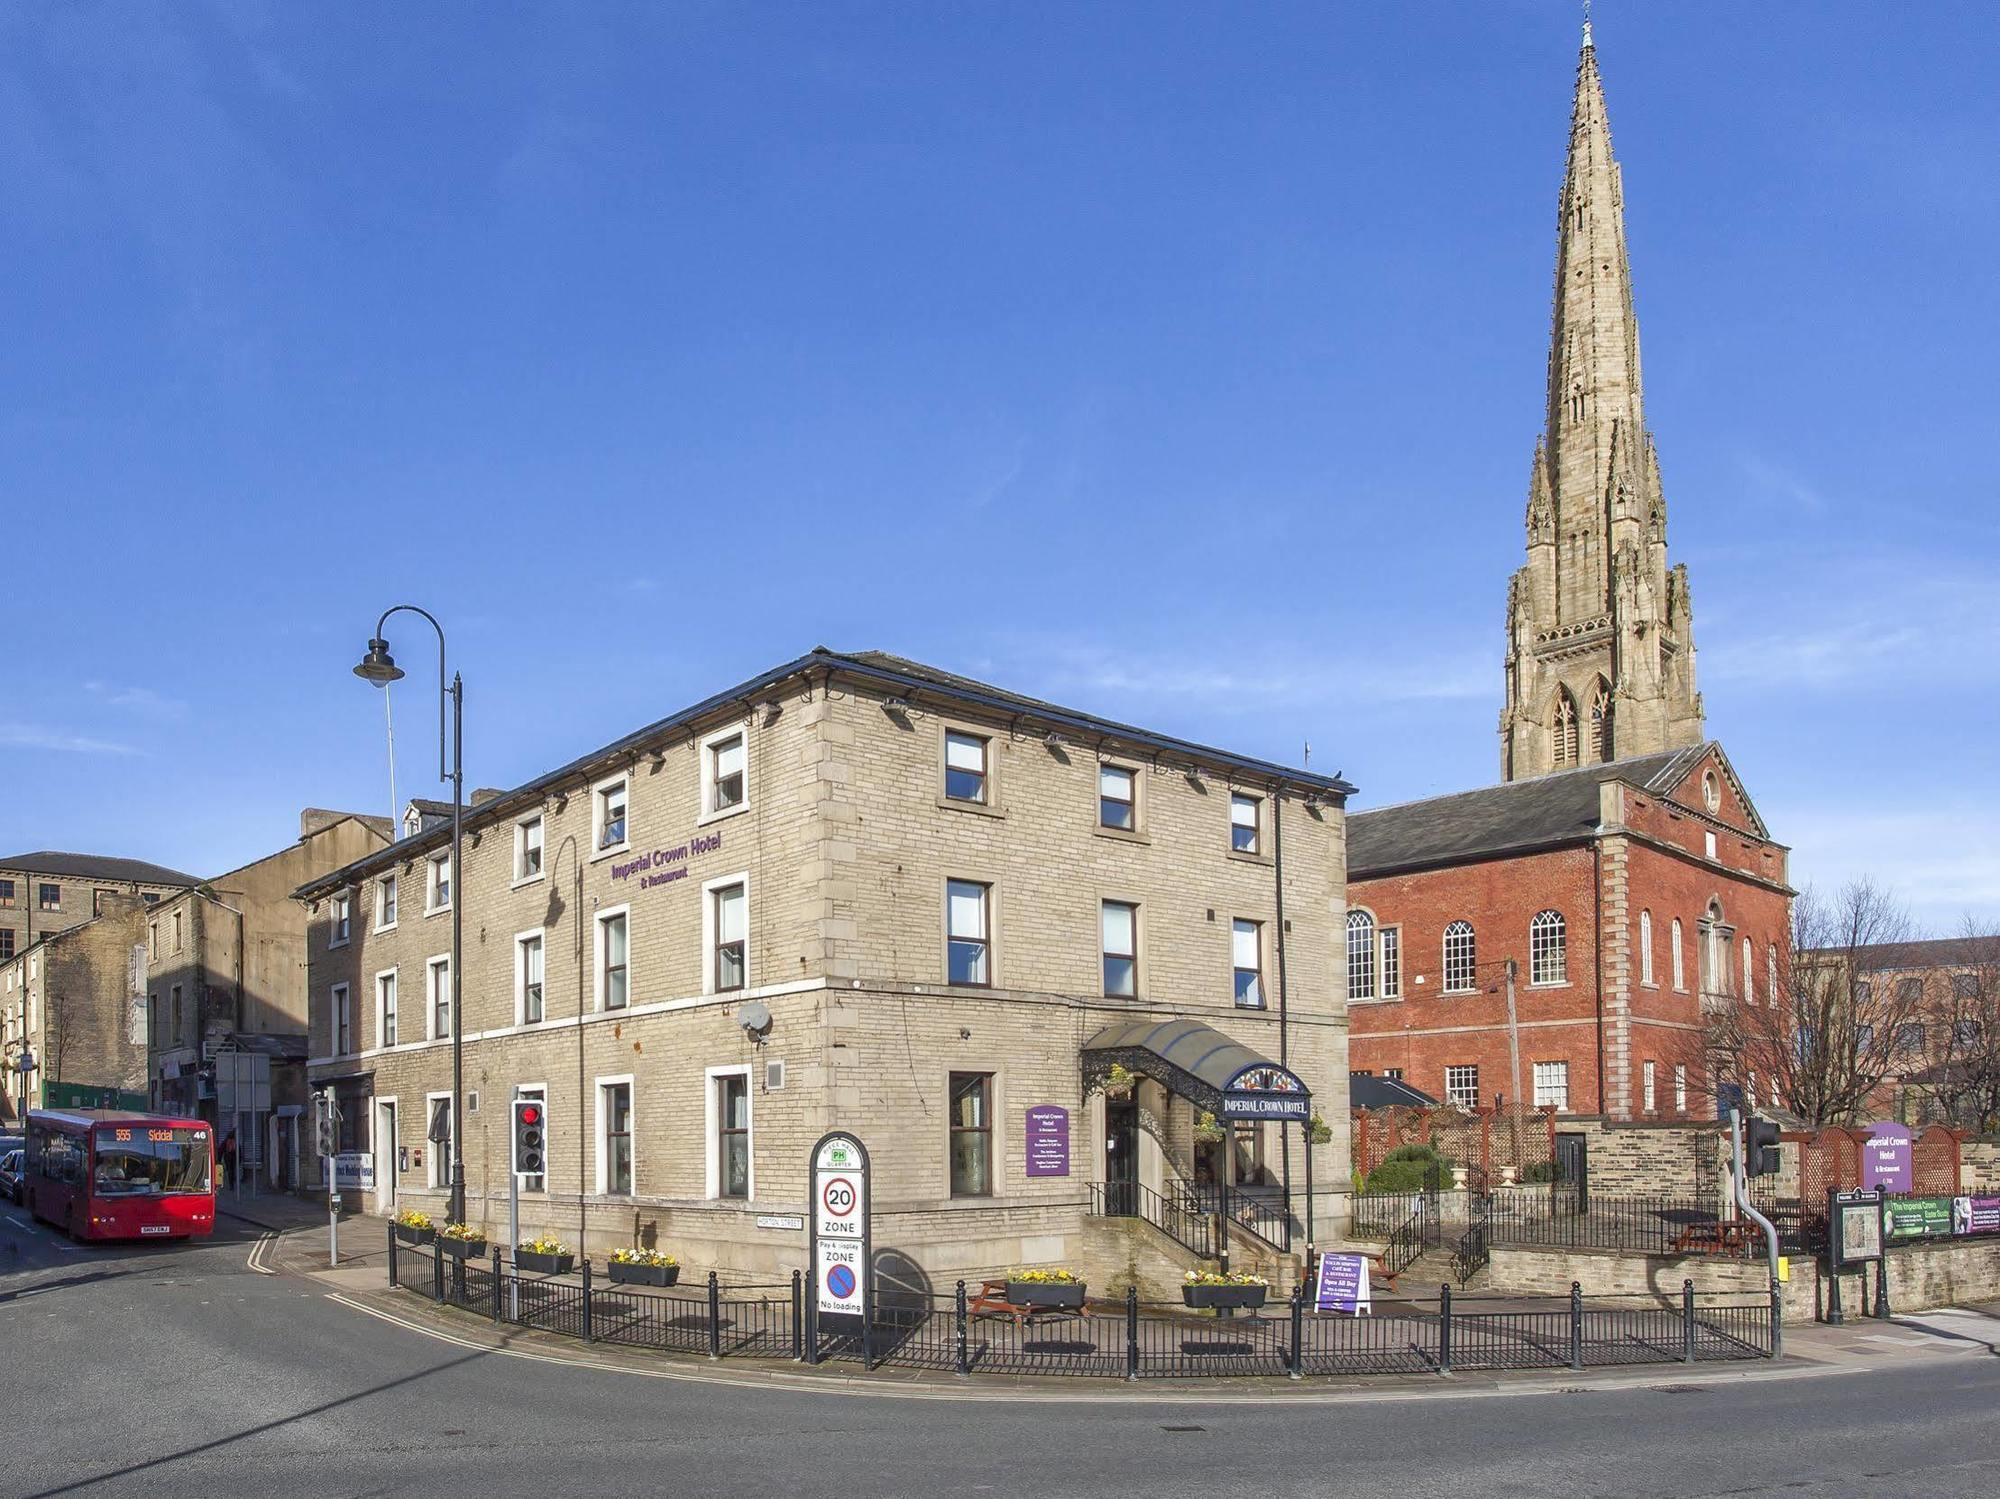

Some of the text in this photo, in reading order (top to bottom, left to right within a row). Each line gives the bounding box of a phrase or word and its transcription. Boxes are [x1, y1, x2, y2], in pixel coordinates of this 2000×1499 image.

[612, 830, 721, 880] Imperial Crown Hotel
[648, 866, 688, 887] Restaurant
[1224, 1099, 1307, 1114] IMPERIAL CROWN HOTEL
[116, 1129, 131, 1141] 555
[148, 1129, 173, 1142] Siddal
[193, 1131, 207, 1140] 46
[1866, 1136, 1908, 1150] mperial Crown
[833, 1151, 846, 1161] PH
[1879, 1149, 1896, 1160] Hotel
[829, 1189, 851, 1206] 20
[1892, 1201, 1937, 1212] The Imperial Crown
[780, 1219, 801, 1228] STREET
[825, 1221, 855, 1233] ZONE
[819, 1241, 831, 1249] Pay
[826, 1251, 855, 1262] ZONE
[1324, 1278, 1338, 1286] Open
[1346, 1280, 1357, 1288] Day
[820, 1300, 861, 1313] No loading
